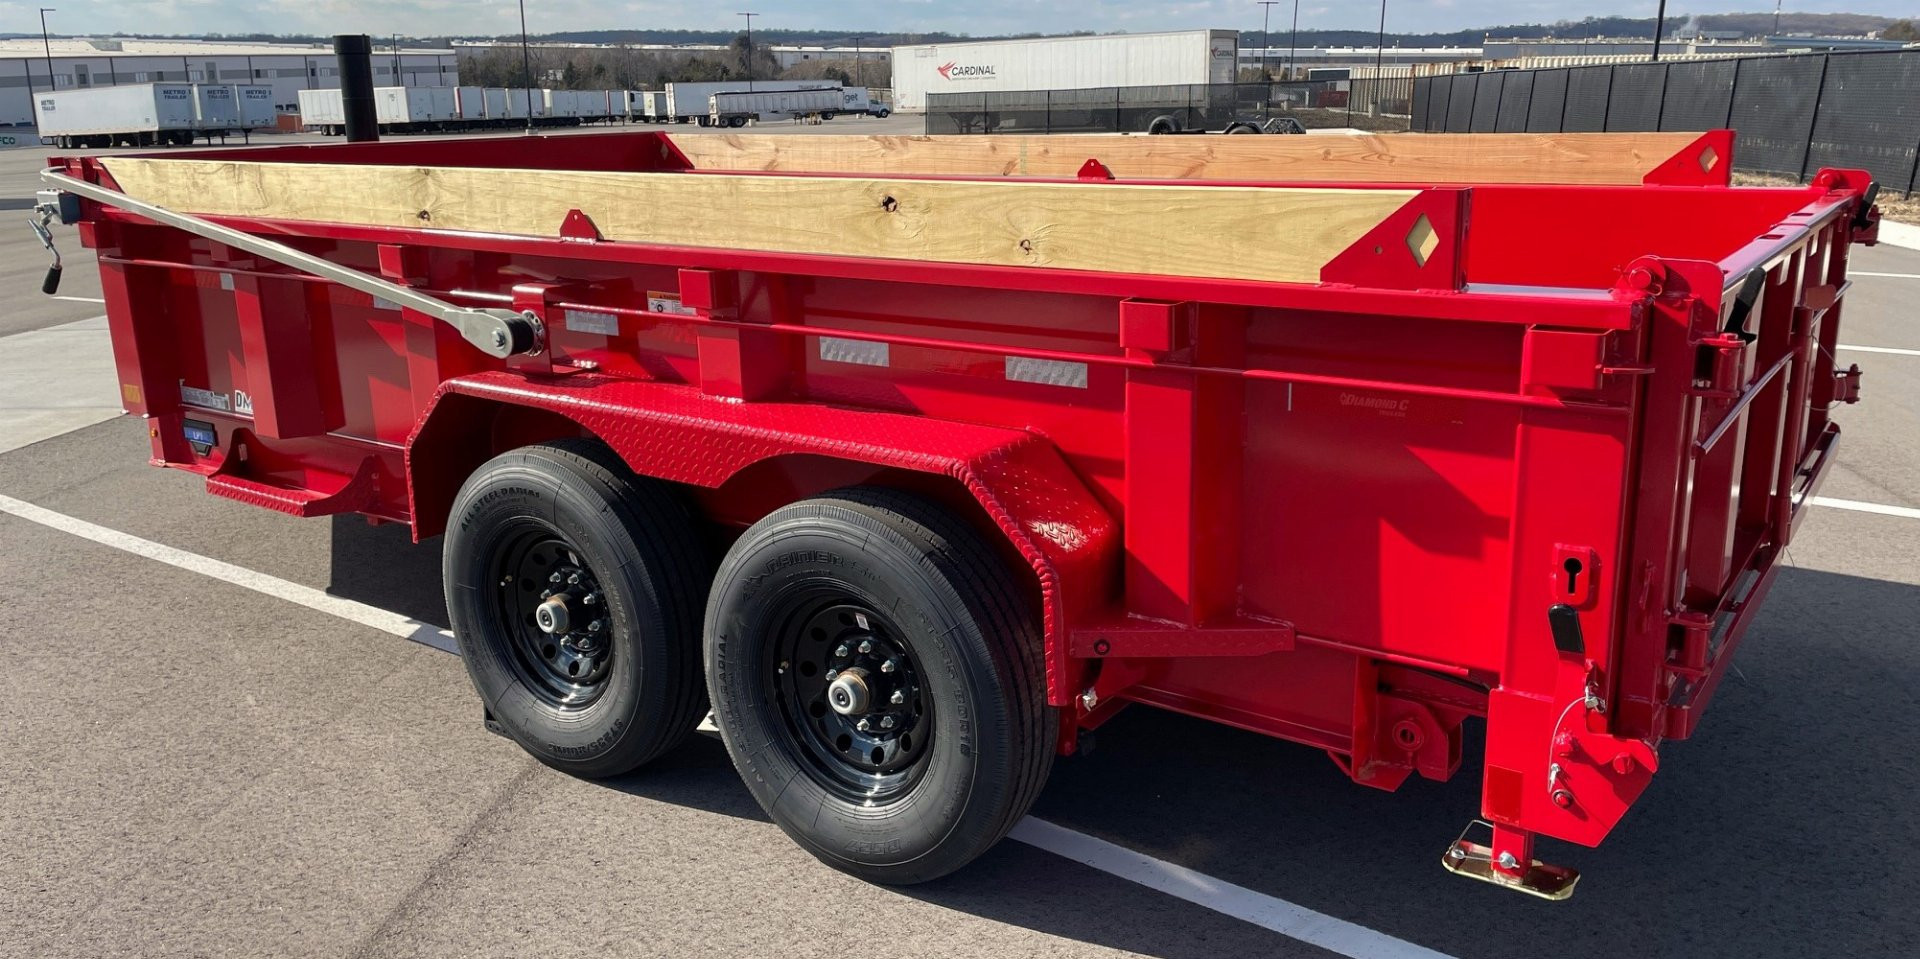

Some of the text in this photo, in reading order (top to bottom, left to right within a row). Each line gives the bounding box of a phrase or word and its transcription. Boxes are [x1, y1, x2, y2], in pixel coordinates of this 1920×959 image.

[951, 65, 996, 76] CARDINAL
[1347, 394, 1409, 411] DIAMOND C
[472, 490, 500, 514] STEEL
[765, 550, 845, 574] RAINIER
[717, 633, 729, 696] RADIAL
